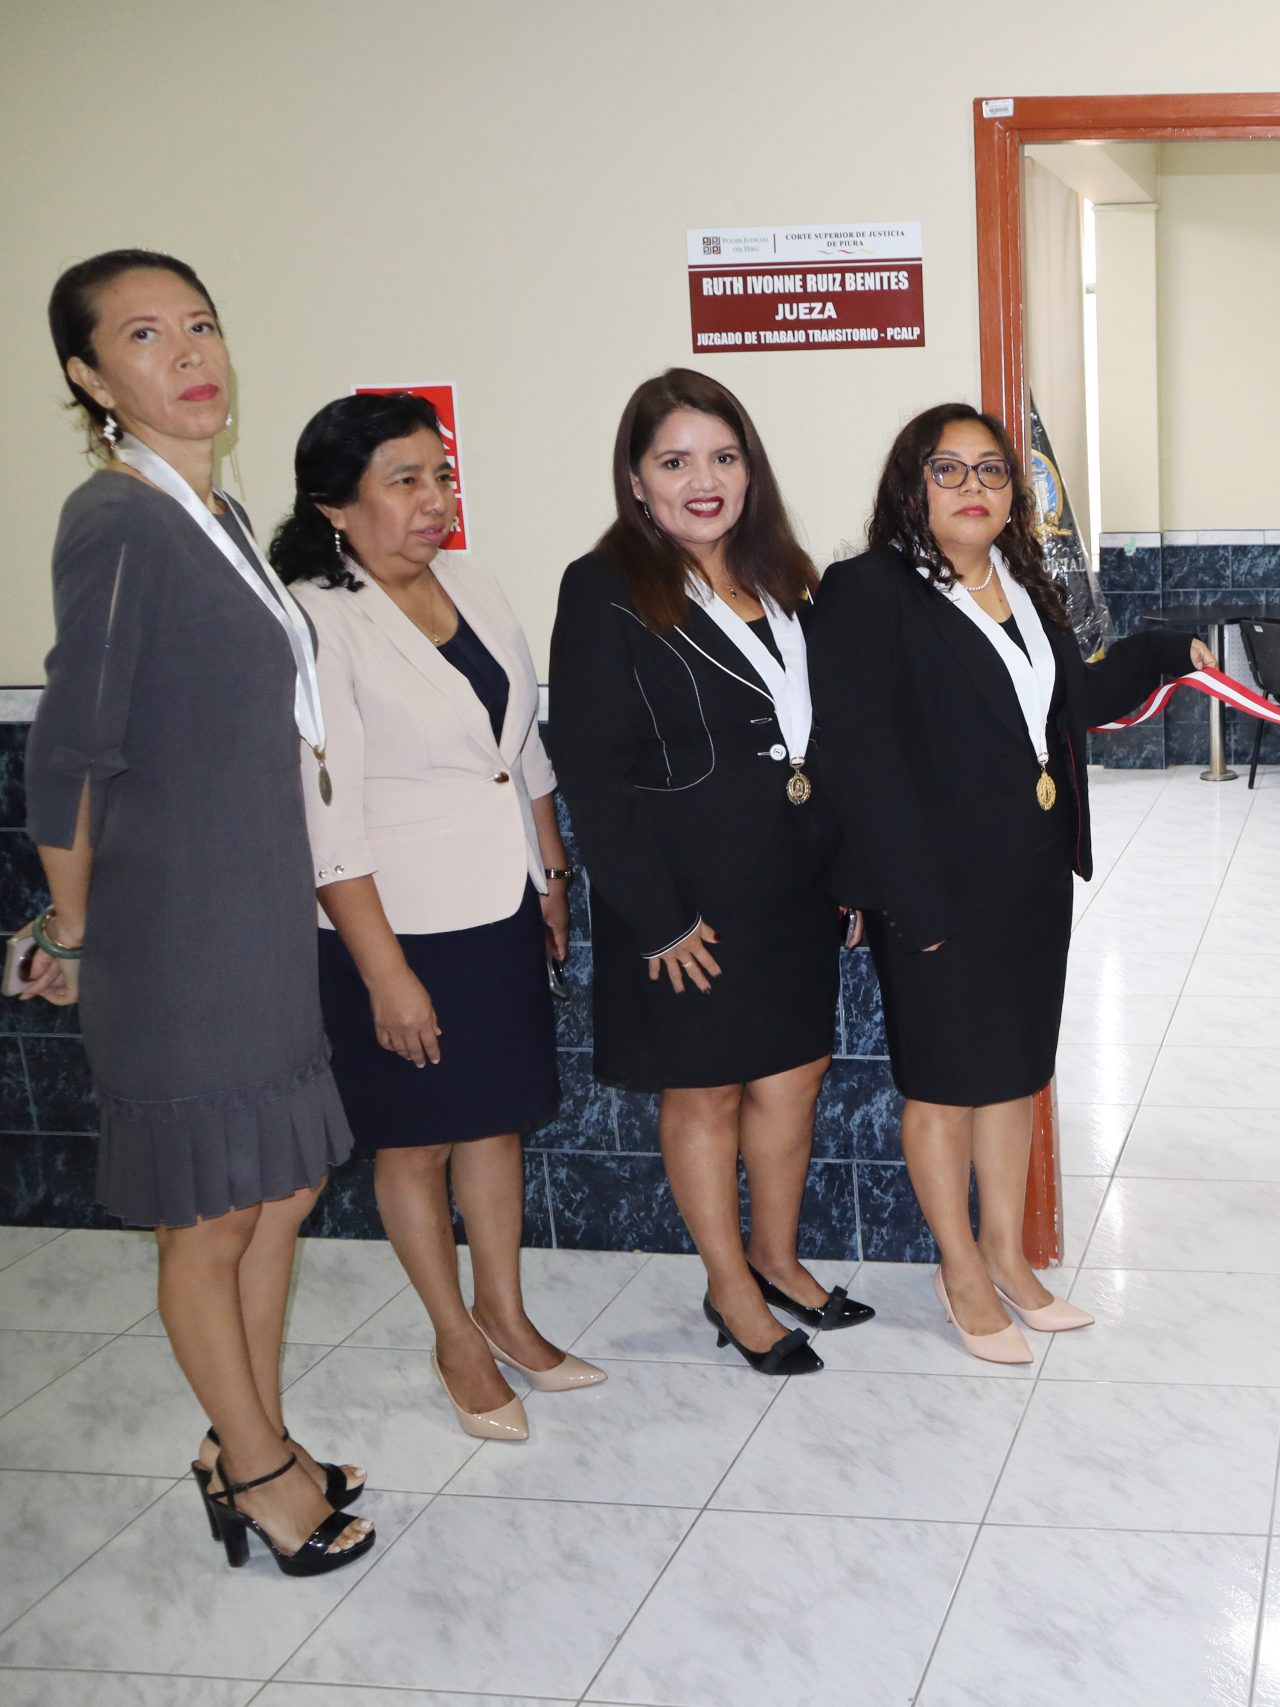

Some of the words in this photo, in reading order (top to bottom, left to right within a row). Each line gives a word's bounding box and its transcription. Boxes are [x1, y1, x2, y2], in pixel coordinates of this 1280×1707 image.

[702, 276, 743, 296] RUTH
[747, 274, 803, 295] IVONNE
[806, 273, 842, 293] RUIZ
[845, 271, 909, 291] BENITES
[775, 302, 837, 320] JUEZA
[697, 332, 742, 346] JUZGADO
[744, 331, 758, 344] DE
[759, 330, 805, 344] TRABAJO
[807, 328, 879, 343] TRANSITORIO
[886, 327, 921, 341] PCALP
